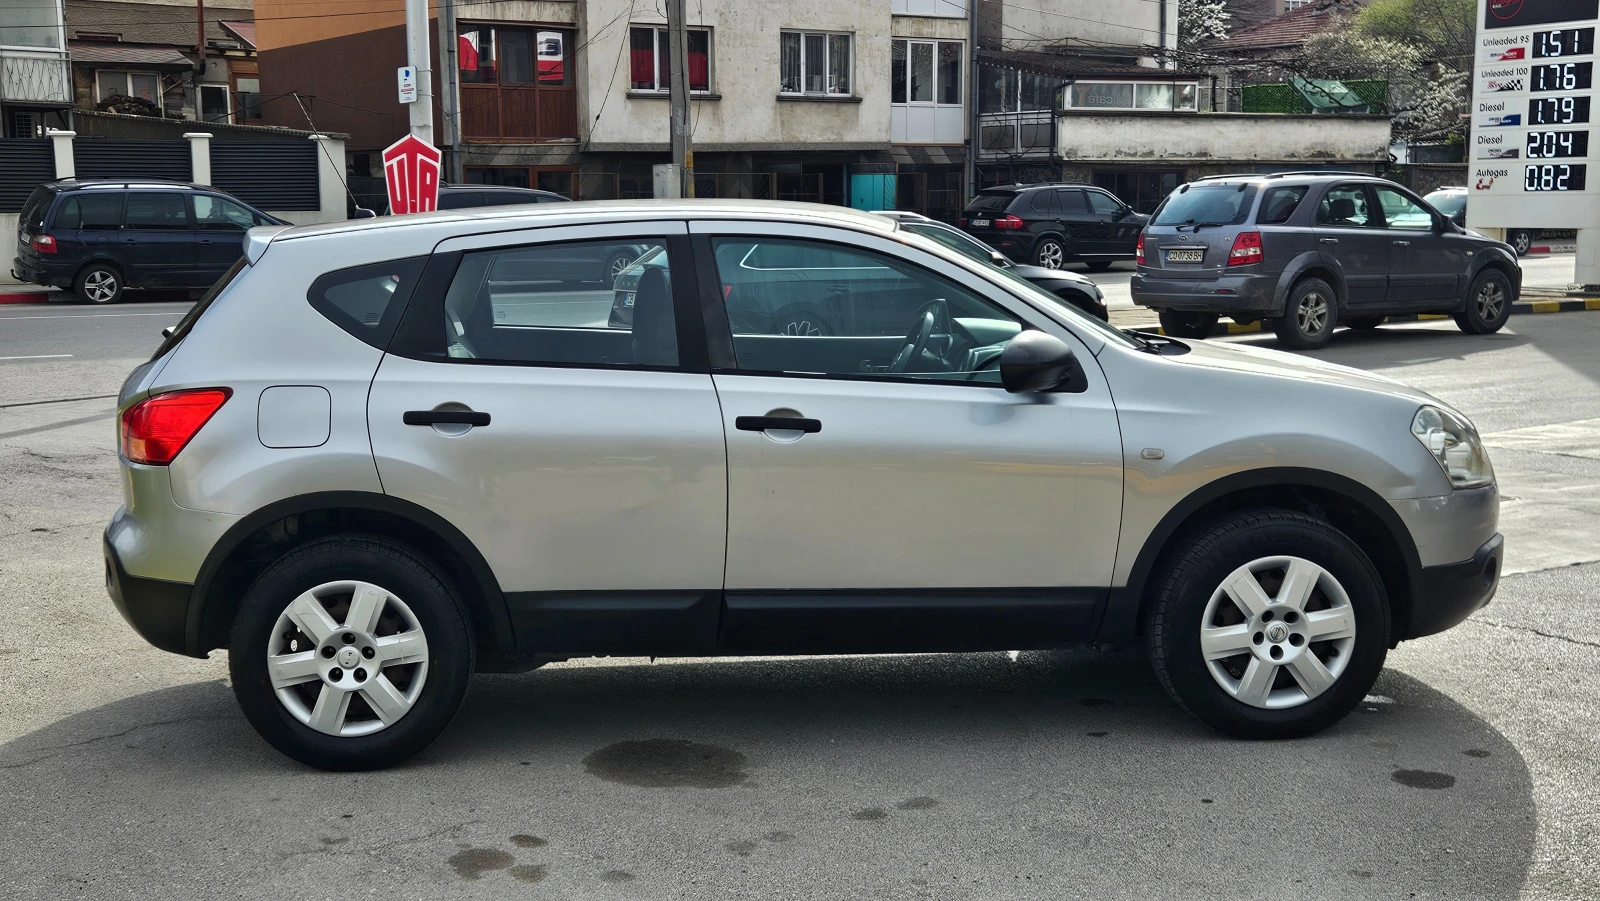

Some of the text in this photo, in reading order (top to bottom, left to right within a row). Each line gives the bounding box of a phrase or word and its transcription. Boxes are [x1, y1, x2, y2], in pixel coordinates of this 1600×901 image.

[1483, 30, 1579, 56] Unleaded 95 1.51
[1481, 63, 1576, 90] Unleaded 100 1.76
[1479, 97, 1574, 124] Diesel 1.79
[1477, 134, 1503, 144] Diesel
[1527, 131, 1573, 157] 2.04
[1476, 164, 1570, 190] Autogas 0.82
